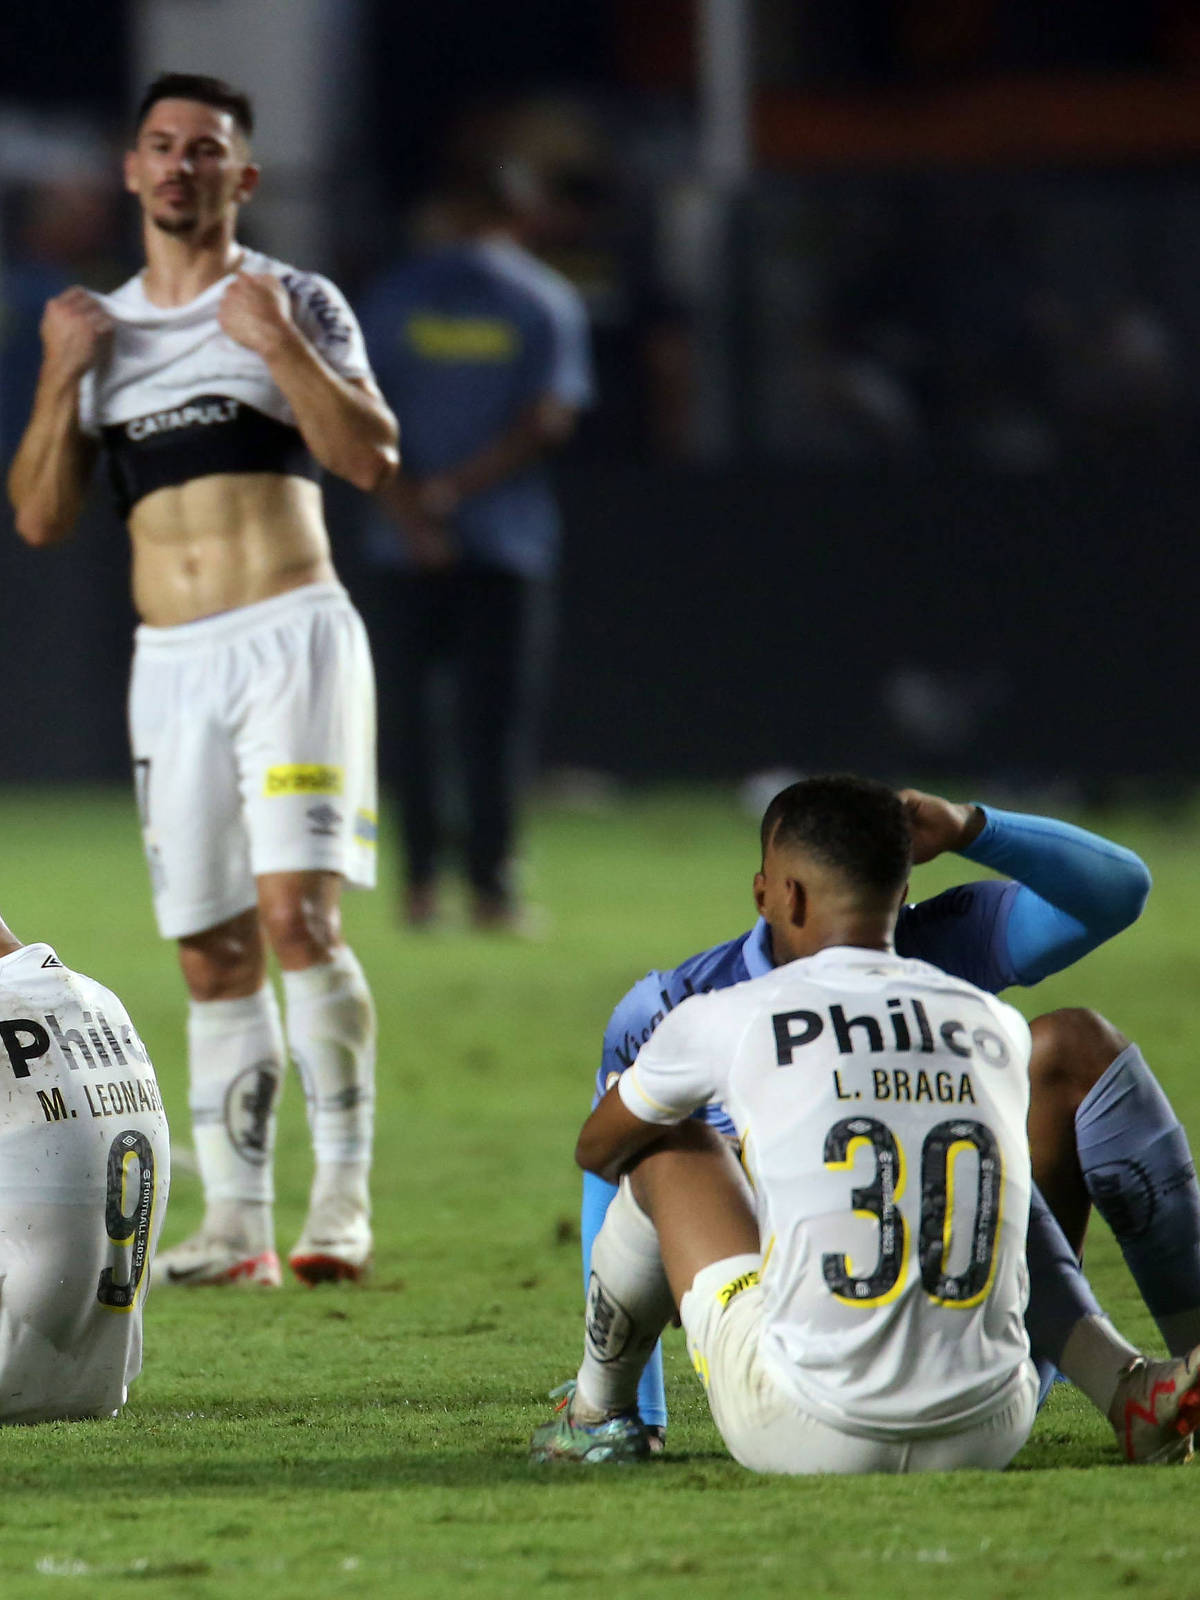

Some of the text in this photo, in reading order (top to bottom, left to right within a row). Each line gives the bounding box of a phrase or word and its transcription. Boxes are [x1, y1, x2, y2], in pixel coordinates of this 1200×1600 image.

[126, 400, 238, 441] CATAPULT
[773, 998, 1010, 1069] Philco
[36, 1078, 163, 1122] M. LEONAR
[833, 1069, 977, 1105] L. BRAGA
[97, 1130, 157, 1313] 9
[135, 1180, 151, 1267] FOOTBALL 2023
[822, 1116, 1007, 1309] 30
